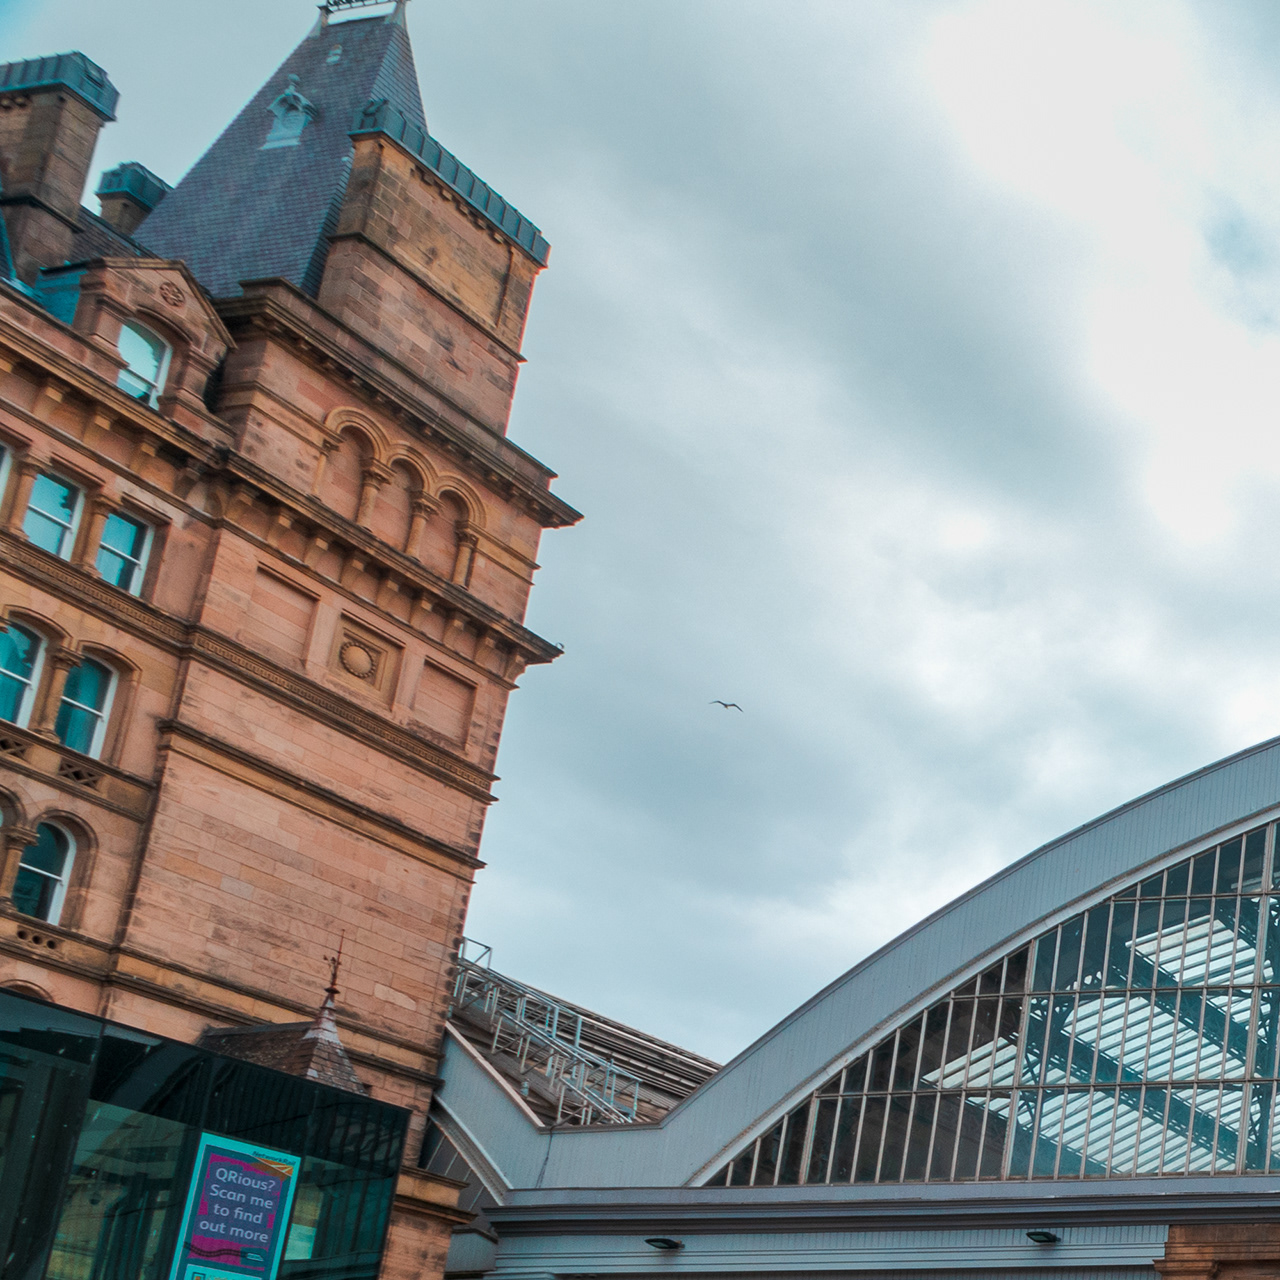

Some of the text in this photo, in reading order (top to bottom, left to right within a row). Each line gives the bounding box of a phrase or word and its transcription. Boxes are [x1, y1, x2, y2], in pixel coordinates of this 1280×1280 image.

[215, 1167, 276, 1192] QRious?
[209, 1184, 274, 1209] Scan me
[213, 1204, 263, 1224] to find
[199, 1220, 269, 1243] out more
